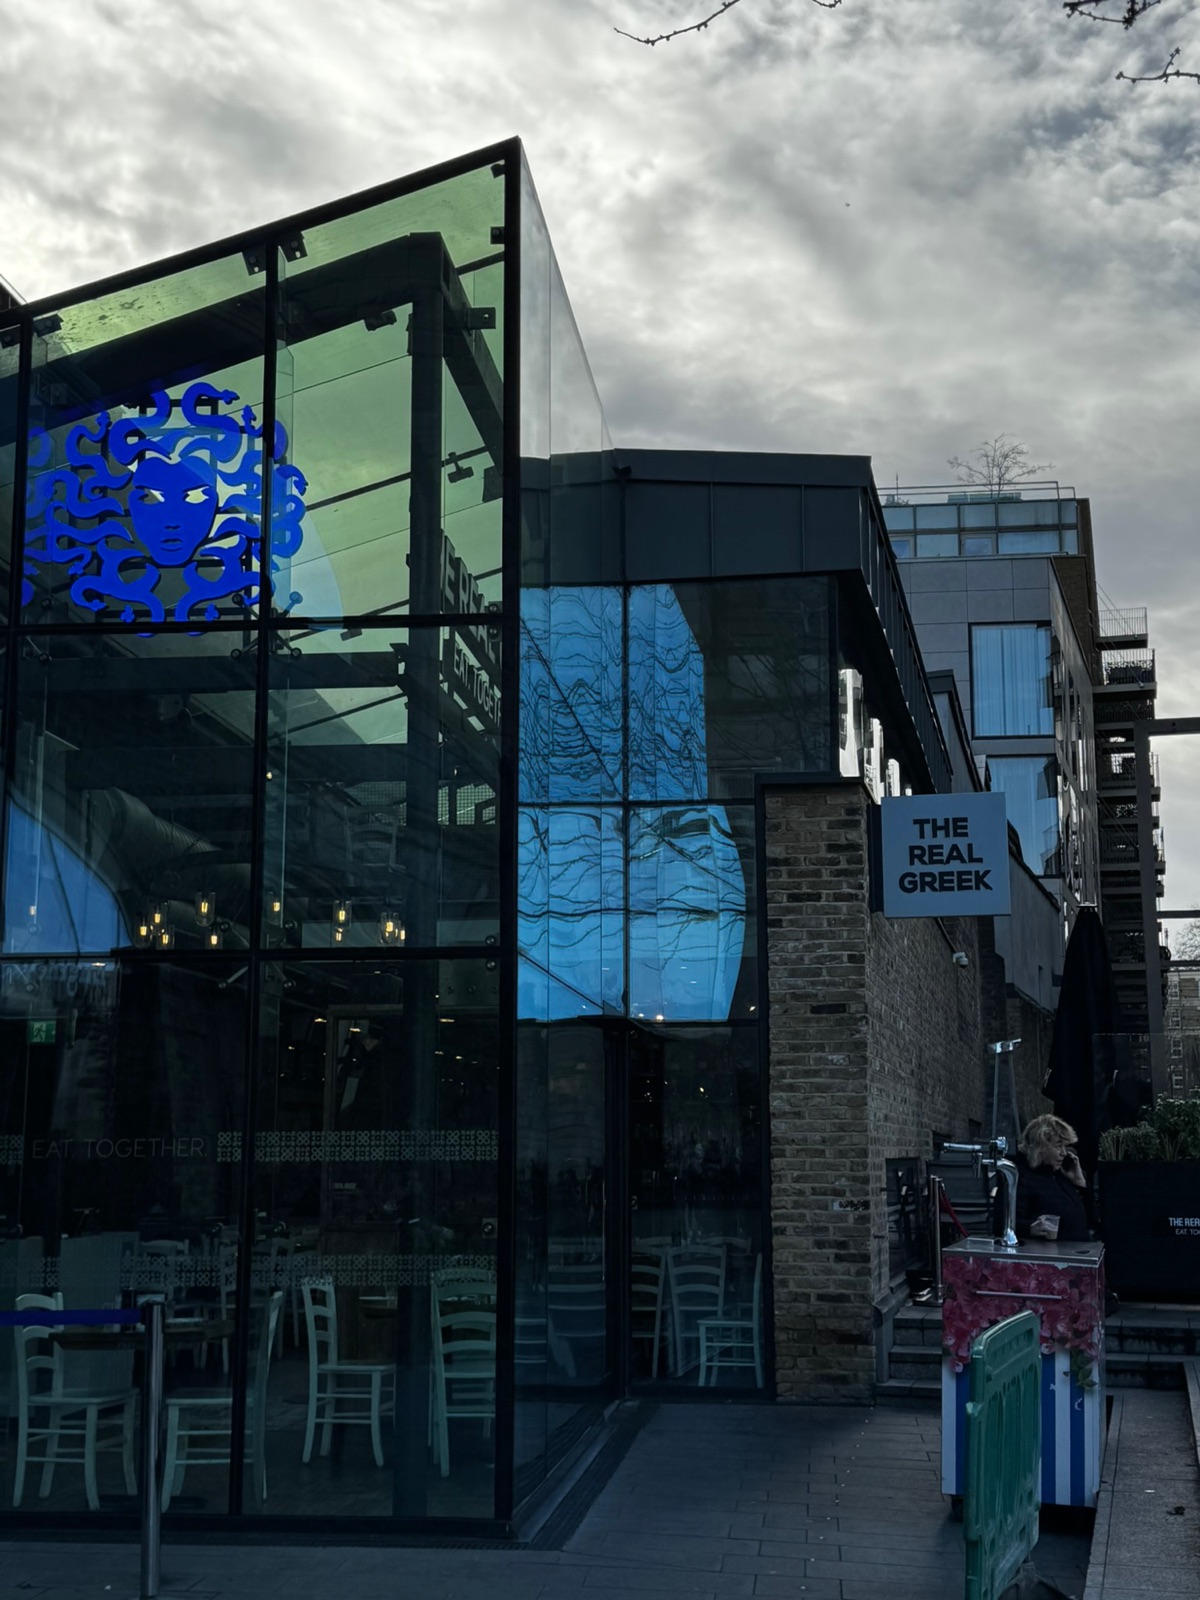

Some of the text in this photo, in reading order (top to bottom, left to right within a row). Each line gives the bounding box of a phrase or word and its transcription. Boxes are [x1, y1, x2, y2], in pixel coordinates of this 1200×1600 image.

[913, 817, 969, 839] THE
[909, 843, 984, 866] REAL
[899, 869, 993, 893] GREEK
[31, 1136, 208, 1160] EAT. TOGETHER.
[1168, 1217, 1184, 1227] THE
